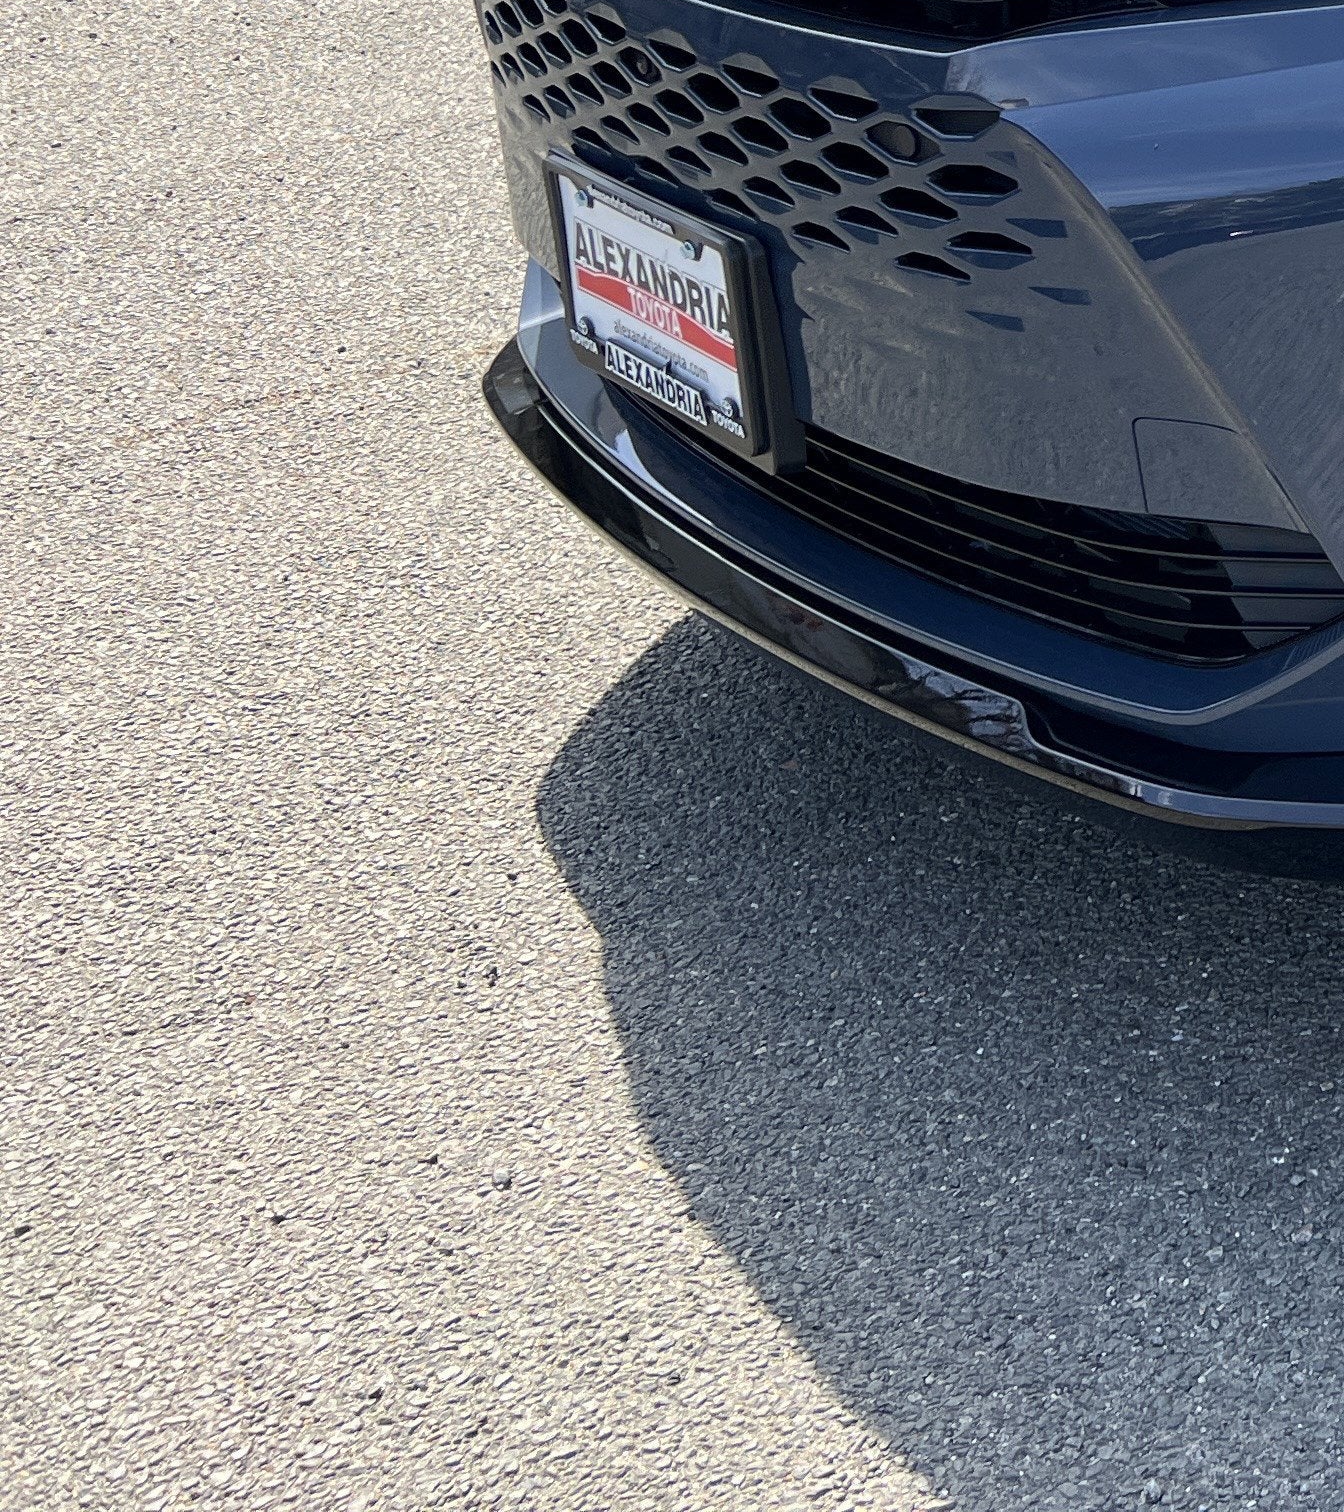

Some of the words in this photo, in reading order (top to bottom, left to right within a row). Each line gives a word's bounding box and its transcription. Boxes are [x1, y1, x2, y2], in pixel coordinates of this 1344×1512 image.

[575, 220, 733, 338] ALEXANDRIA
[626, 286, 684, 339] TOYOTA
[569, 328, 599, 355] TOYOTA
[606, 344, 706, 424] ALEXANDRIA
[710, 409, 747, 439] TOYOTA
